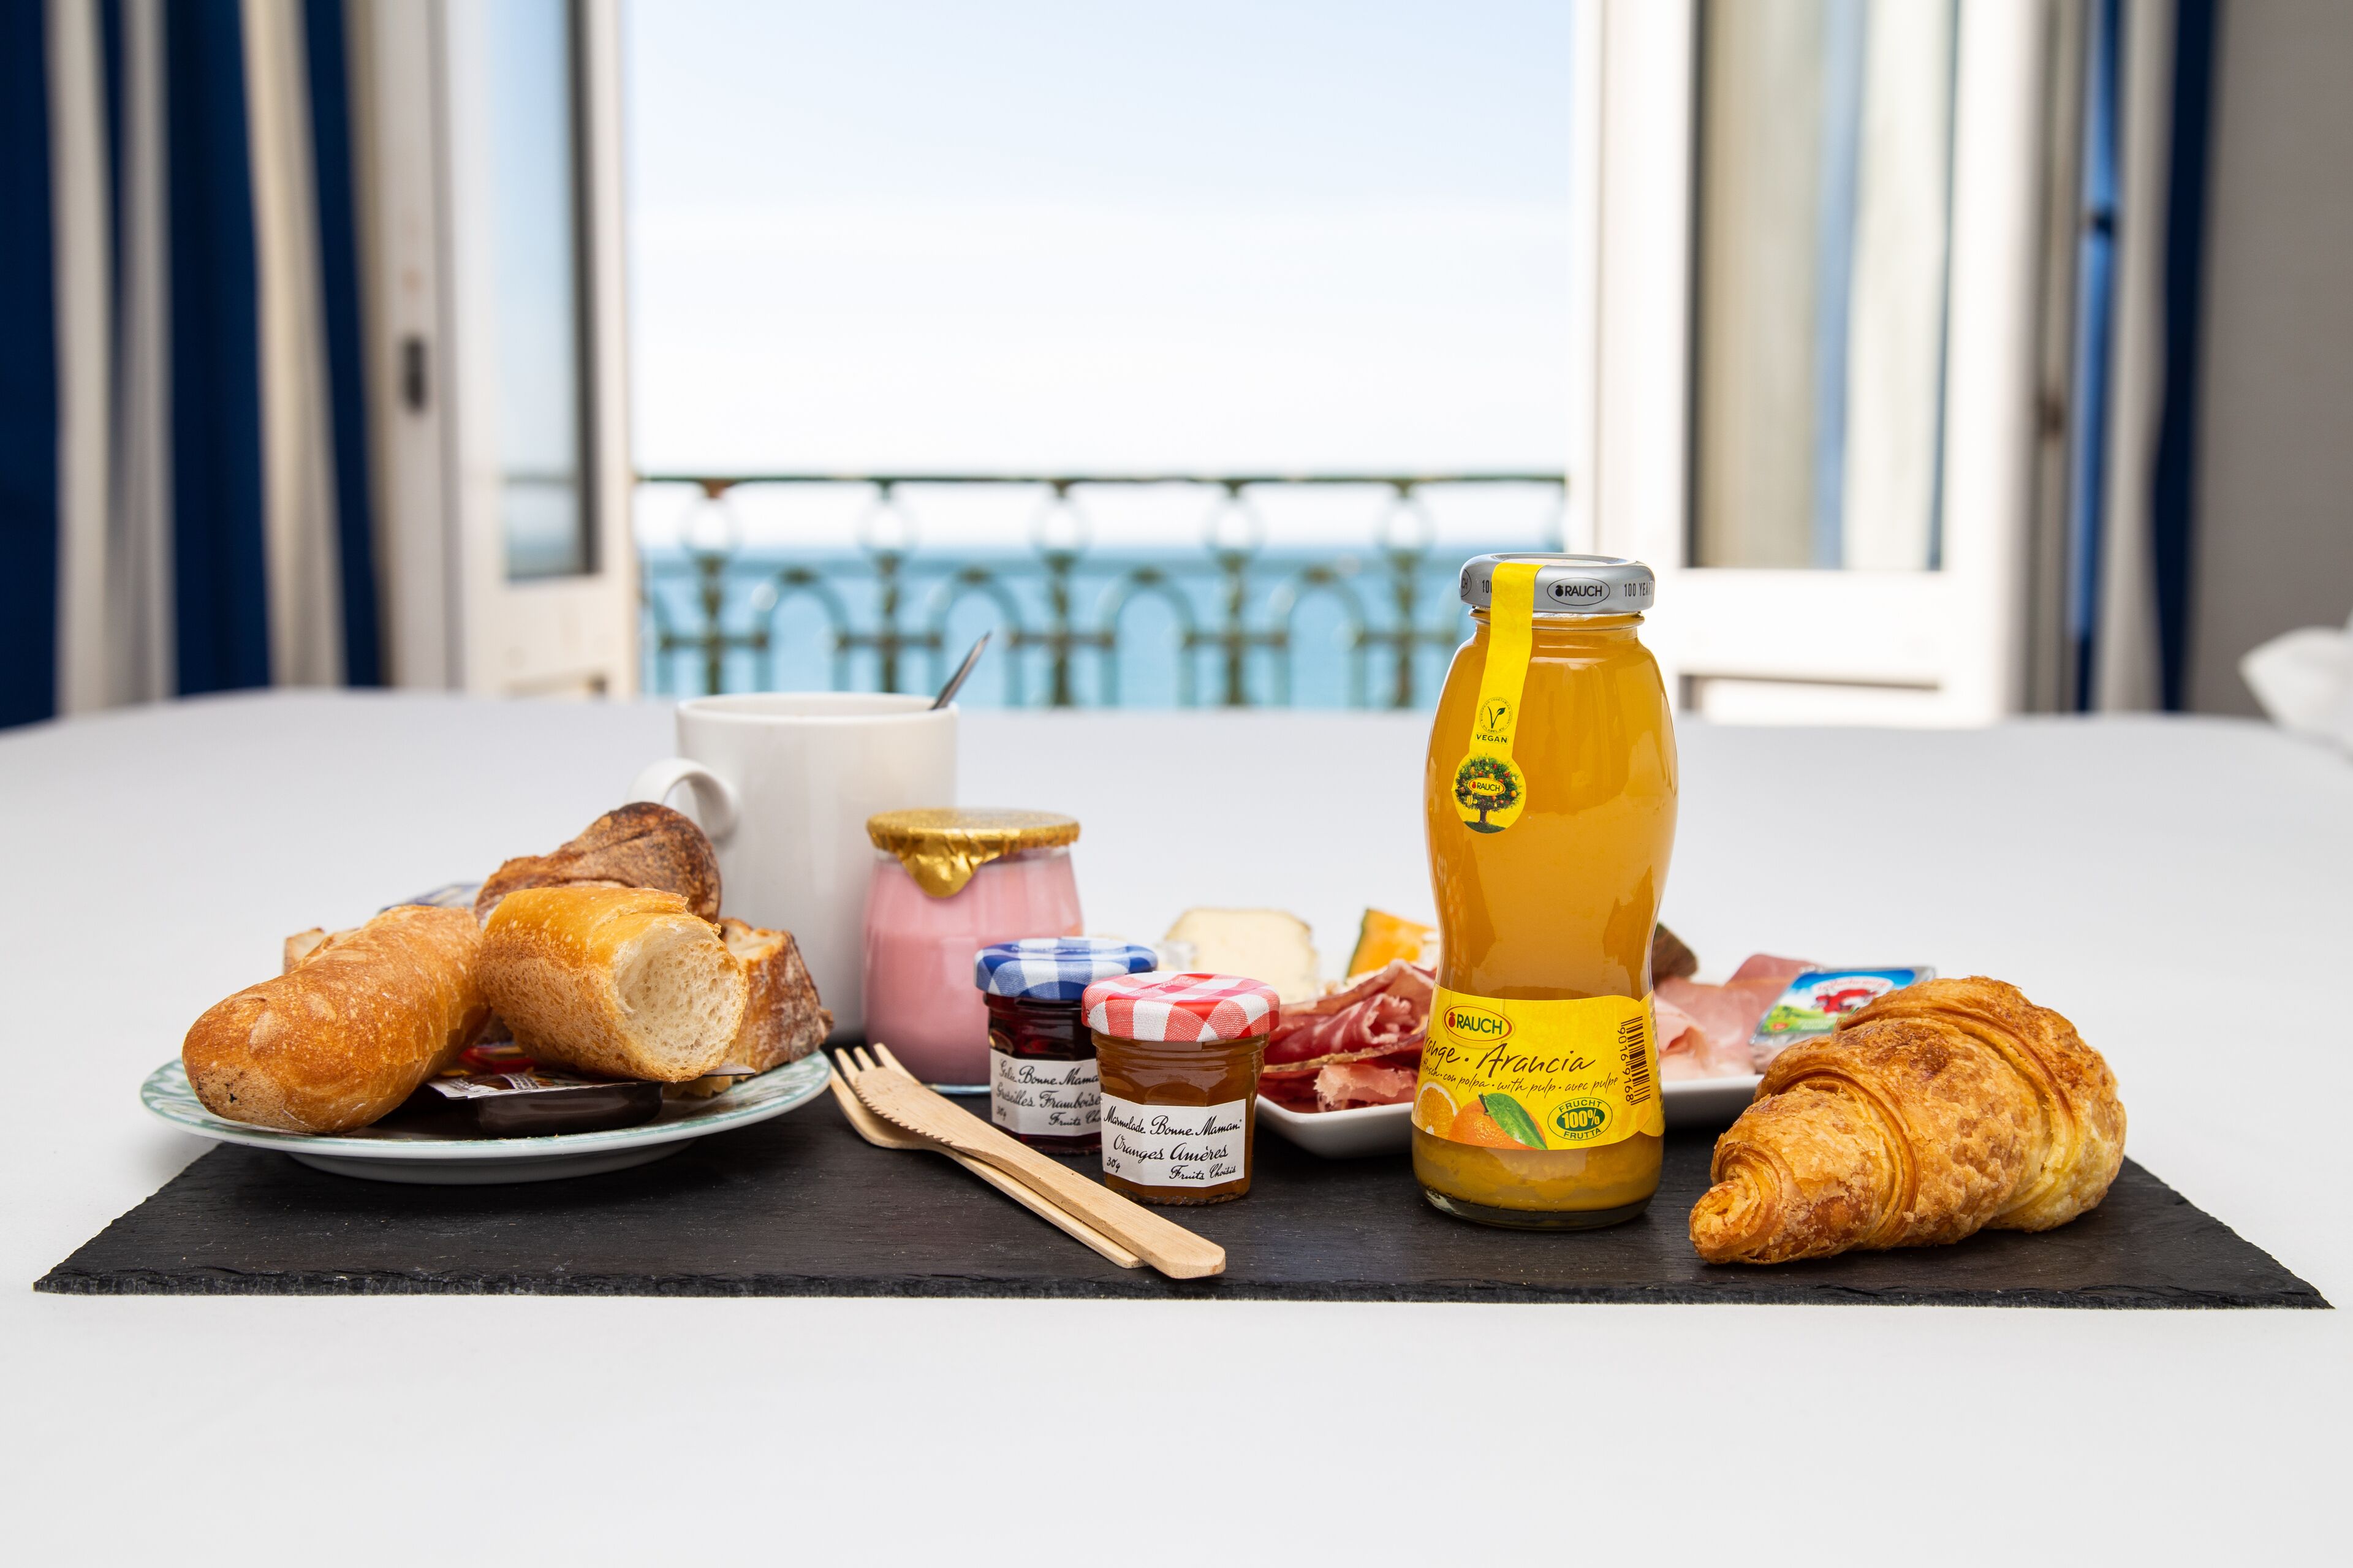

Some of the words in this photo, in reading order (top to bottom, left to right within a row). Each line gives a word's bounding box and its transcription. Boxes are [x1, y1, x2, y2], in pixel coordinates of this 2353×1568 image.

[1564, 585, 1603, 597] RAUCH
[1624, 583, 1637, 597] 100
[1476, 733, 1508, 744] VEGAN
[1476, 782, 1501, 792] RAUCH
[1456, 1013, 1502, 1036] RAUCH
[1423, 1036, 1461, 1070] range
[1476, 1042, 1596, 1078] Arancia
[1018, 1065, 1058, 1085] Bonne
[1442, 1074, 1457, 1083] con
[1455, 1074, 1490, 1093] polpa
[1497, 1078, 1528, 1093] with
[1526, 1078, 1558, 1099] pulp
[1564, 1081, 1589, 1092] avec
[1590, 1072, 1618, 1096] pulpe
[1558, 1099, 1602, 1113] FRUCHT
[1048, 1112, 1082, 1126] Fruits
[1104, 1105, 1146, 1134] Marmelade
[1150, 1115, 1194, 1135] Bonne
[1562, 1109, 1601, 1129] 100%
[1563, 1128, 1602, 1139] FRUTTA
[1113, 1134, 1165, 1164] Oranges
[1170, 1142, 1229, 1162] Amères
[1169, 1164, 1205, 1180] Fruits
[1209, 1163, 1237, 1179] Choisis
